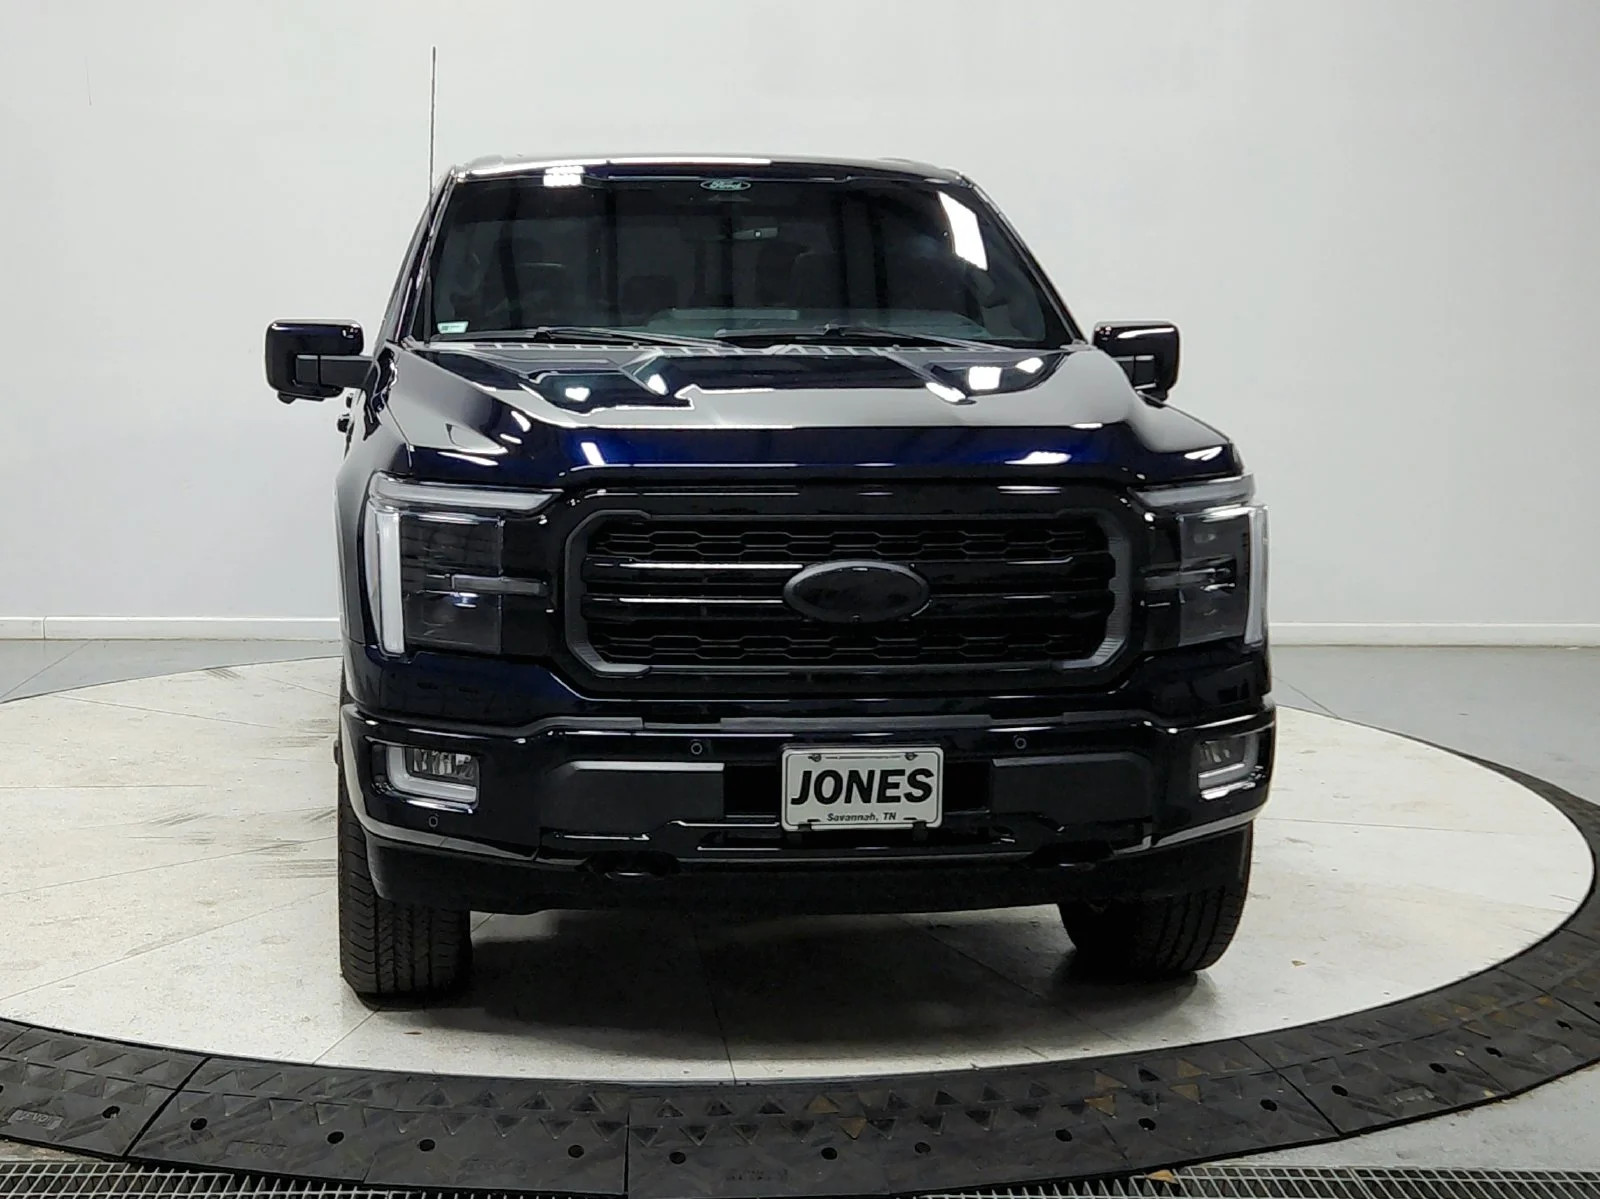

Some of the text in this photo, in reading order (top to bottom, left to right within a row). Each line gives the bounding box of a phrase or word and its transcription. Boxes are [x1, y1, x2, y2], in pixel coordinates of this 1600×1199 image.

[708, 179, 743, 190] Ford
[790, 768, 934, 805] JONES
[827, 811, 897, 822] Savannah, TN
